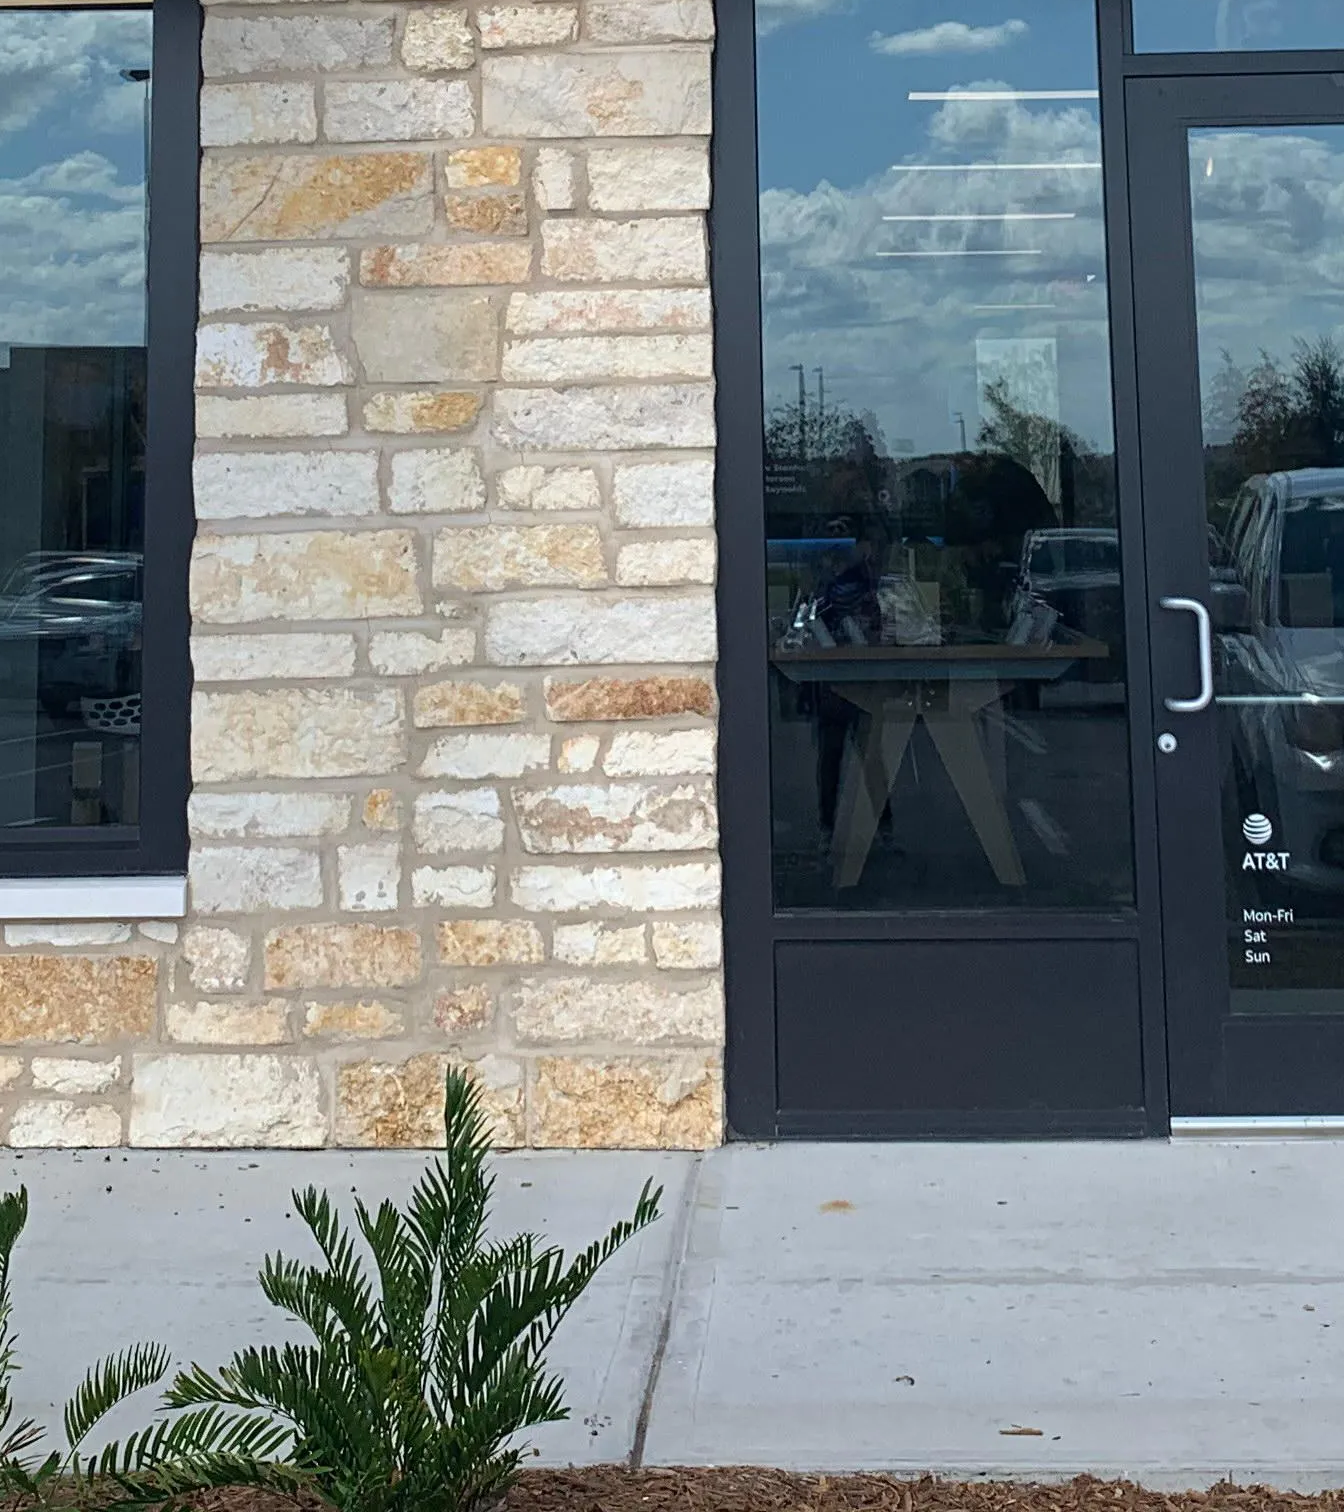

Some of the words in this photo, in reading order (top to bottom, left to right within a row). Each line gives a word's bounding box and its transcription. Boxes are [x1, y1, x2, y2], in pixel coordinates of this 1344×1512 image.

[1242, 852, 1290, 870] AT&T
[1242, 908, 1294, 923] Mon-Fri
[1244, 929, 1267, 943] Sat
[1245, 949, 1271, 963] Sun
